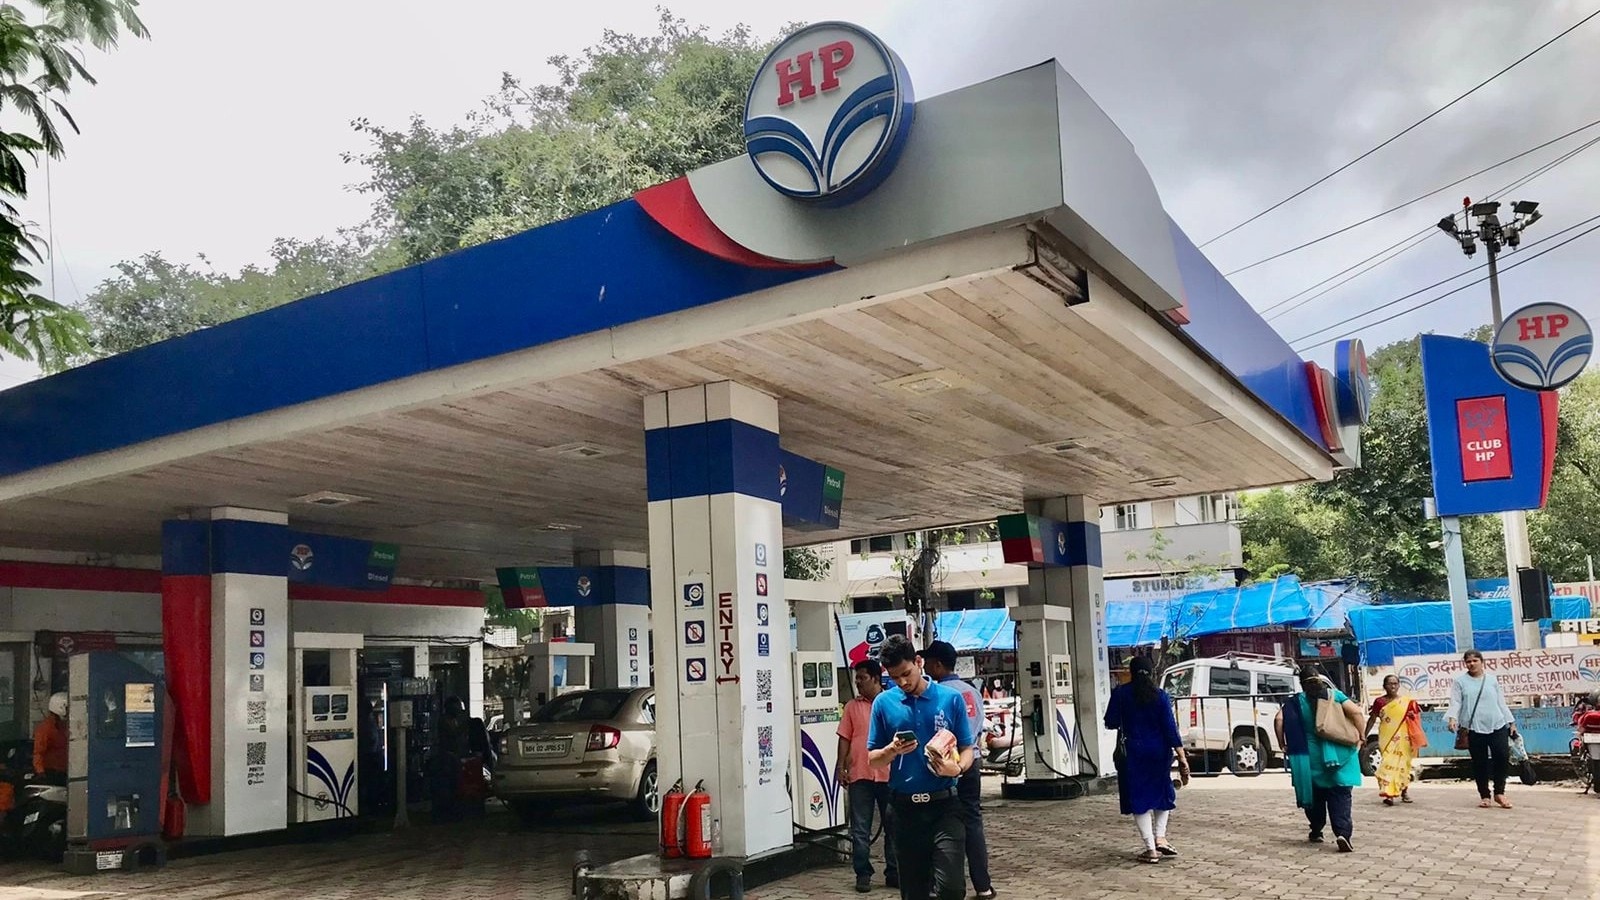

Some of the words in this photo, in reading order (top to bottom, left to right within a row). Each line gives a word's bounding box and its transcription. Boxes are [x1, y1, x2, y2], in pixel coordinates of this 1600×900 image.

[775, 40, 855, 106] HP
[1517, 314, 1569, 341] HP
[1467, 439, 1502, 451] CLUB
[1475, 451, 1495, 462] HP
[826, 476, 841, 489] Petrol
[374, 551, 394, 560] Petrol
[368, 573, 388, 582] Diesel
[719, 592, 735, 674] ENTRY
[1501, 652, 1532, 671] सर्विस
[1535, 651, 1575, 669] स्टेशन
[1405, 667, 1420, 677] HP
[1496, 671, 1533, 685] ERVICE
[1537, 670, 1580, 683] STATION
[823, 713, 837, 721] Petrol
